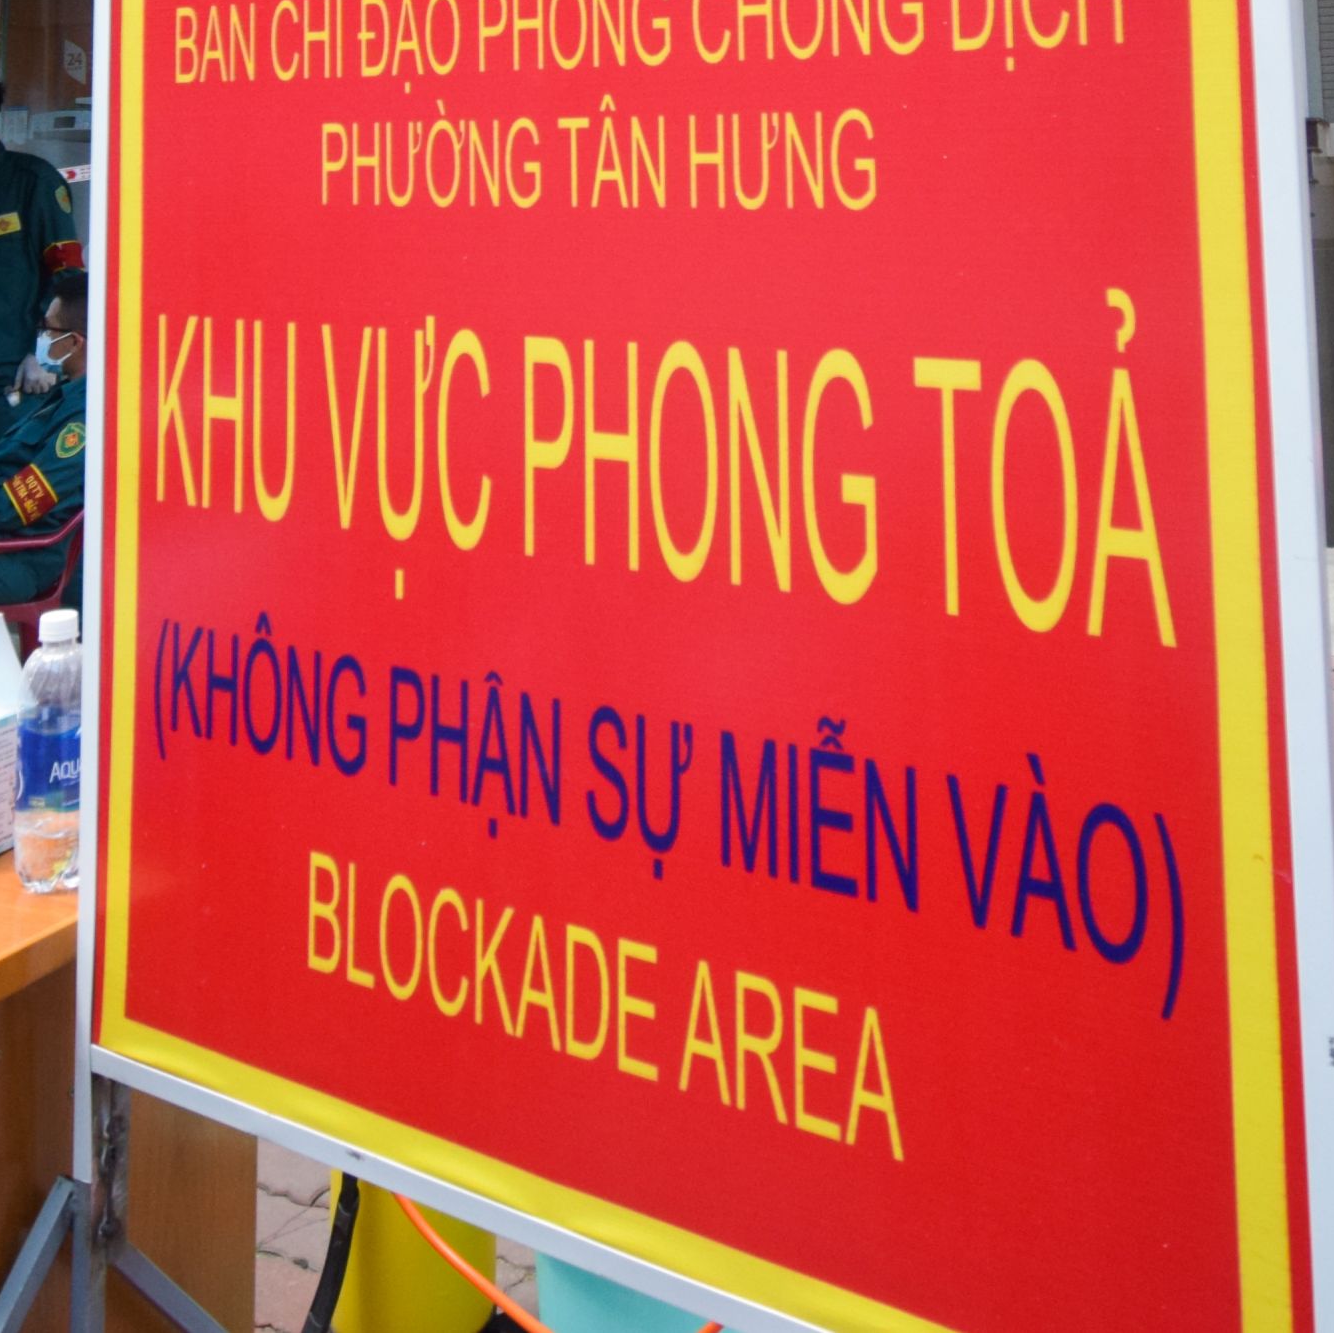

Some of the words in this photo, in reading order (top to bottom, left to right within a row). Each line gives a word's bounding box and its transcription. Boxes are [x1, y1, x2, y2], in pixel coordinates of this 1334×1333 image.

[174, 3, 256, 84] BAN
[322, 101, 542, 208] PHƯỜNG
[558, 95, 667, 209] TÂN
[688, 109, 878, 212] HƯNG
[155, 314, 297, 524] KHU
[321, 314, 493, 600] VỰC
[524, 336, 879, 605] PHONG
[914, 288, 1178, 649] TOẢ
[153, 612, 368, 777] (KHÔNG
[388, 666, 563, 839] PHẬN
[586, 706, 693, 880] SỰ
[719, 716, 919, 915] MIỄN
[948, 753, 1185, 1021] VÀO)
[307, 850, 660, 1083] BLOCKADE
[679, 959, 906, 1162] AREA
